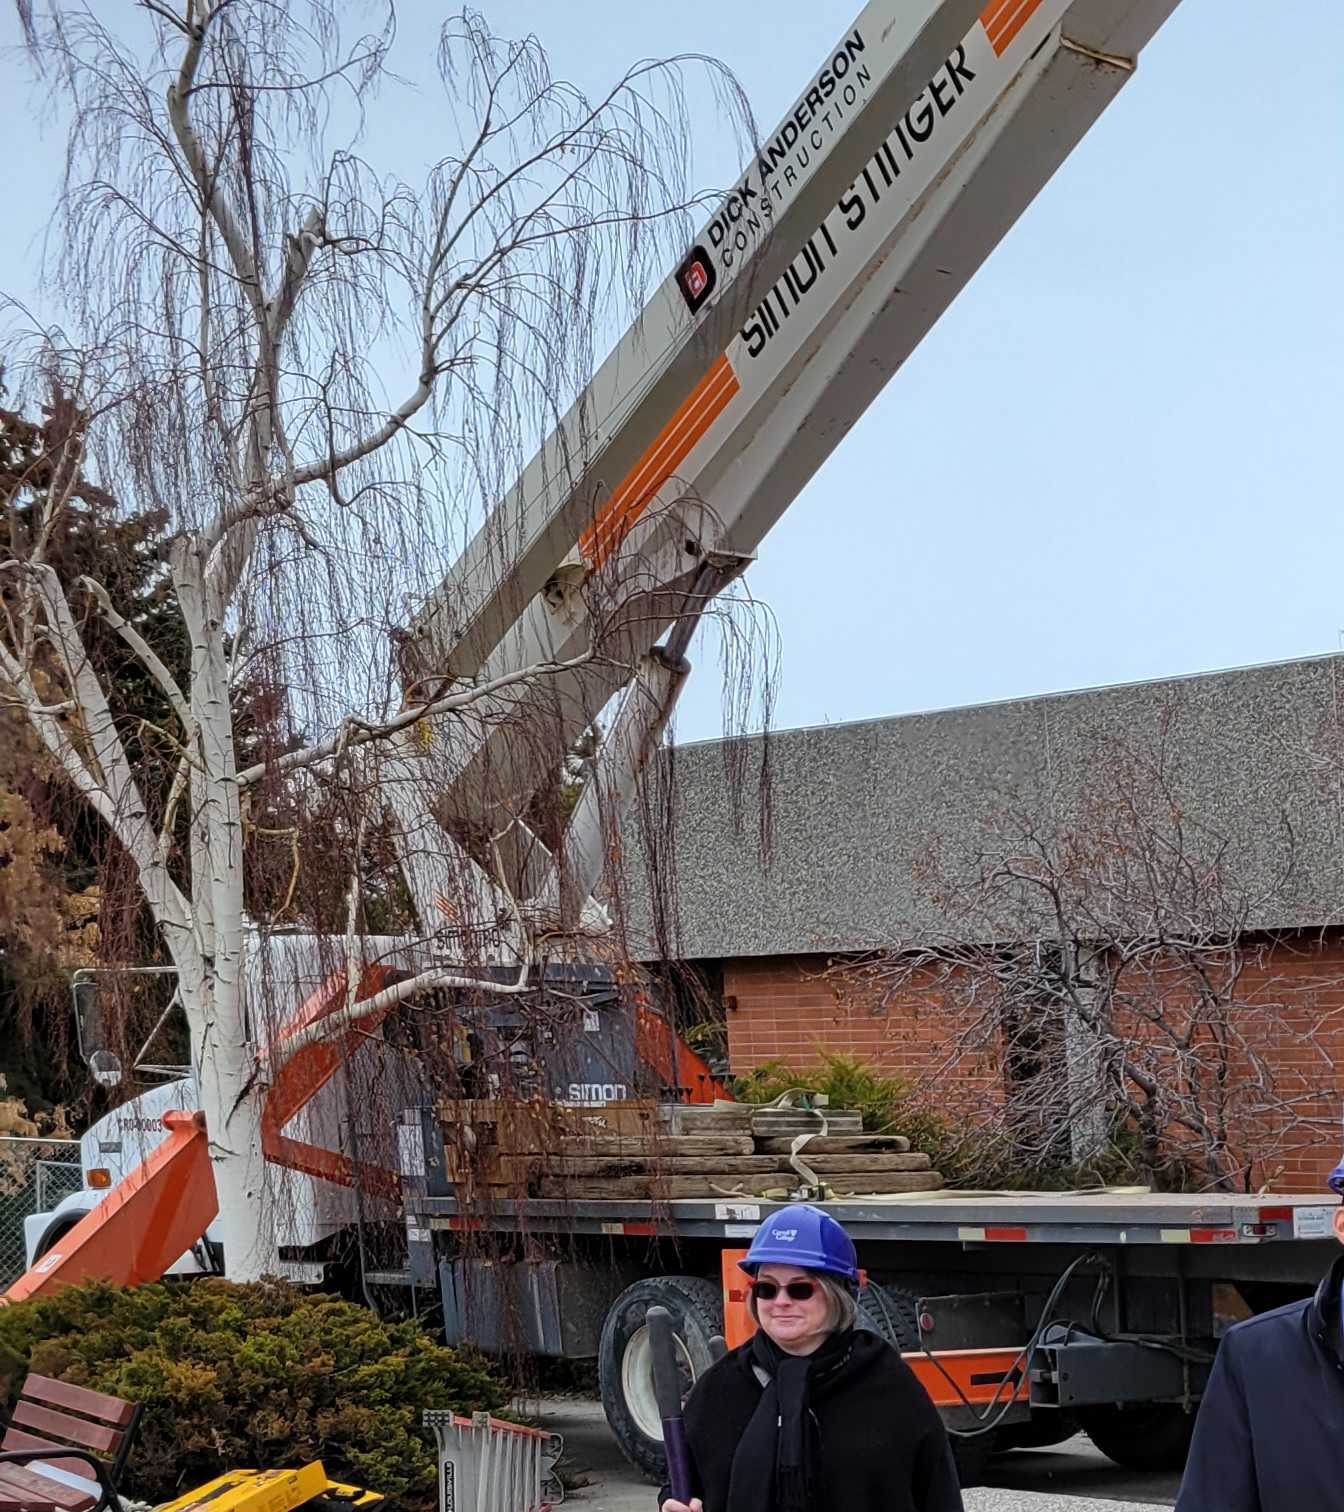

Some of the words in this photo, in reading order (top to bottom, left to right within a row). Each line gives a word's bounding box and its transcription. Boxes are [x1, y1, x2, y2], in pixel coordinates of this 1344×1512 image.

[707, 178, 756, 248] DICK
[757, 29, 866, 186] ANDERSON
[721, 64, 871, 269] CONSTRUCTION
